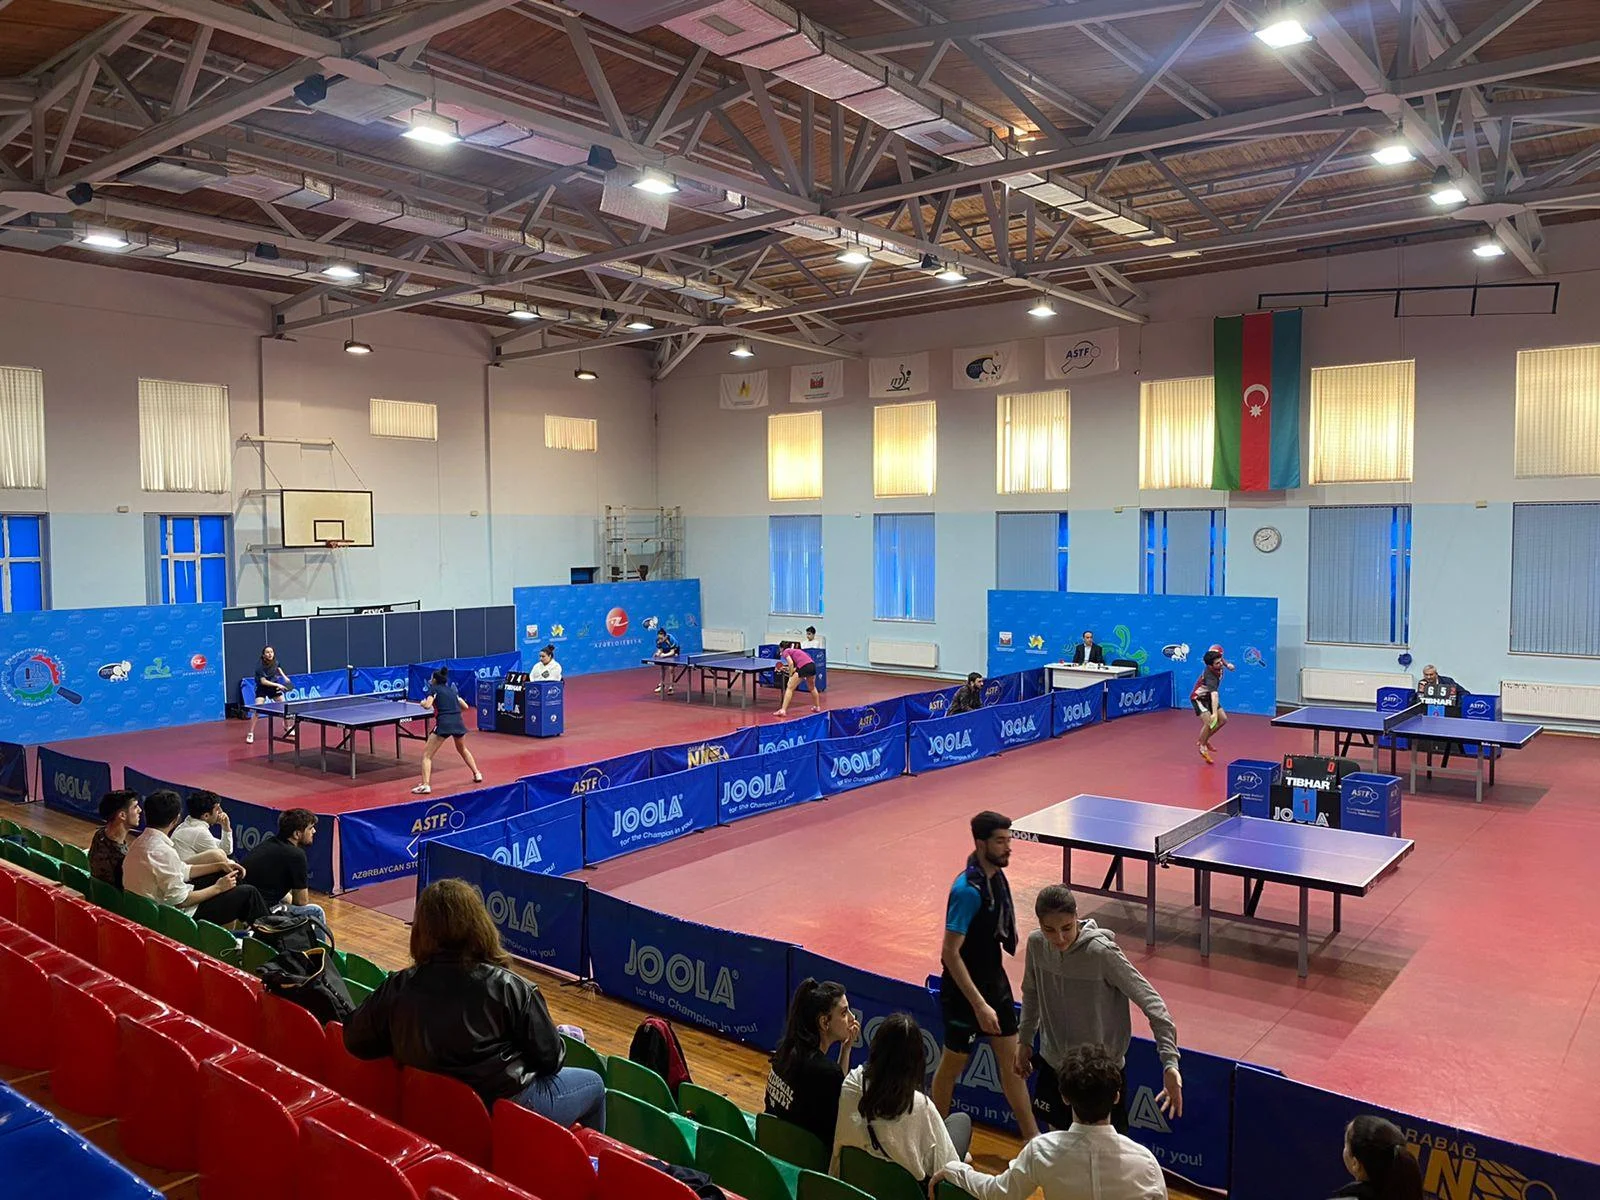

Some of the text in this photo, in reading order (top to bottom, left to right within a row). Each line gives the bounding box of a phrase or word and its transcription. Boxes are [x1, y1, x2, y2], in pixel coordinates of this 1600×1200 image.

[1065, 347, 1090, 359] ASTF
[1427, 686, 1435, 696] 6
[1440, 687, 1448, 696] 5
[929, 700, 944, 711] ASTF
[1063, 700, 1091, 722] JOOLA
[1000, 716, 1036, 738] JOOLA
[928, 730, 972, 756] JOOLA
[830, 748, 881, 777] JOOLA
[571, 777, 598, 794] ASTF
[721, 770, 786, 805] JOOLA
[1285, 777, 1331, 790] TIBHAR
[1301, 799, 1310, 814] 1
[411, 813, 448, 833] ASTF
[612, 795, 684, 837] JOOLA
[620, 837, 631, 847] for
[624, 938, 736, 1010] JOOLA
[635, 986, 647, 997] for
[649, 990, 666, 1004] the
[667, 998, 719, 1030] Champion
[734, 1023, 758, 1033] you!
[984, 1106, 998, 1121] in
[1034, 1098, 1051, 1113] AZE
[1170, 1151, 1203, 1167] you!
